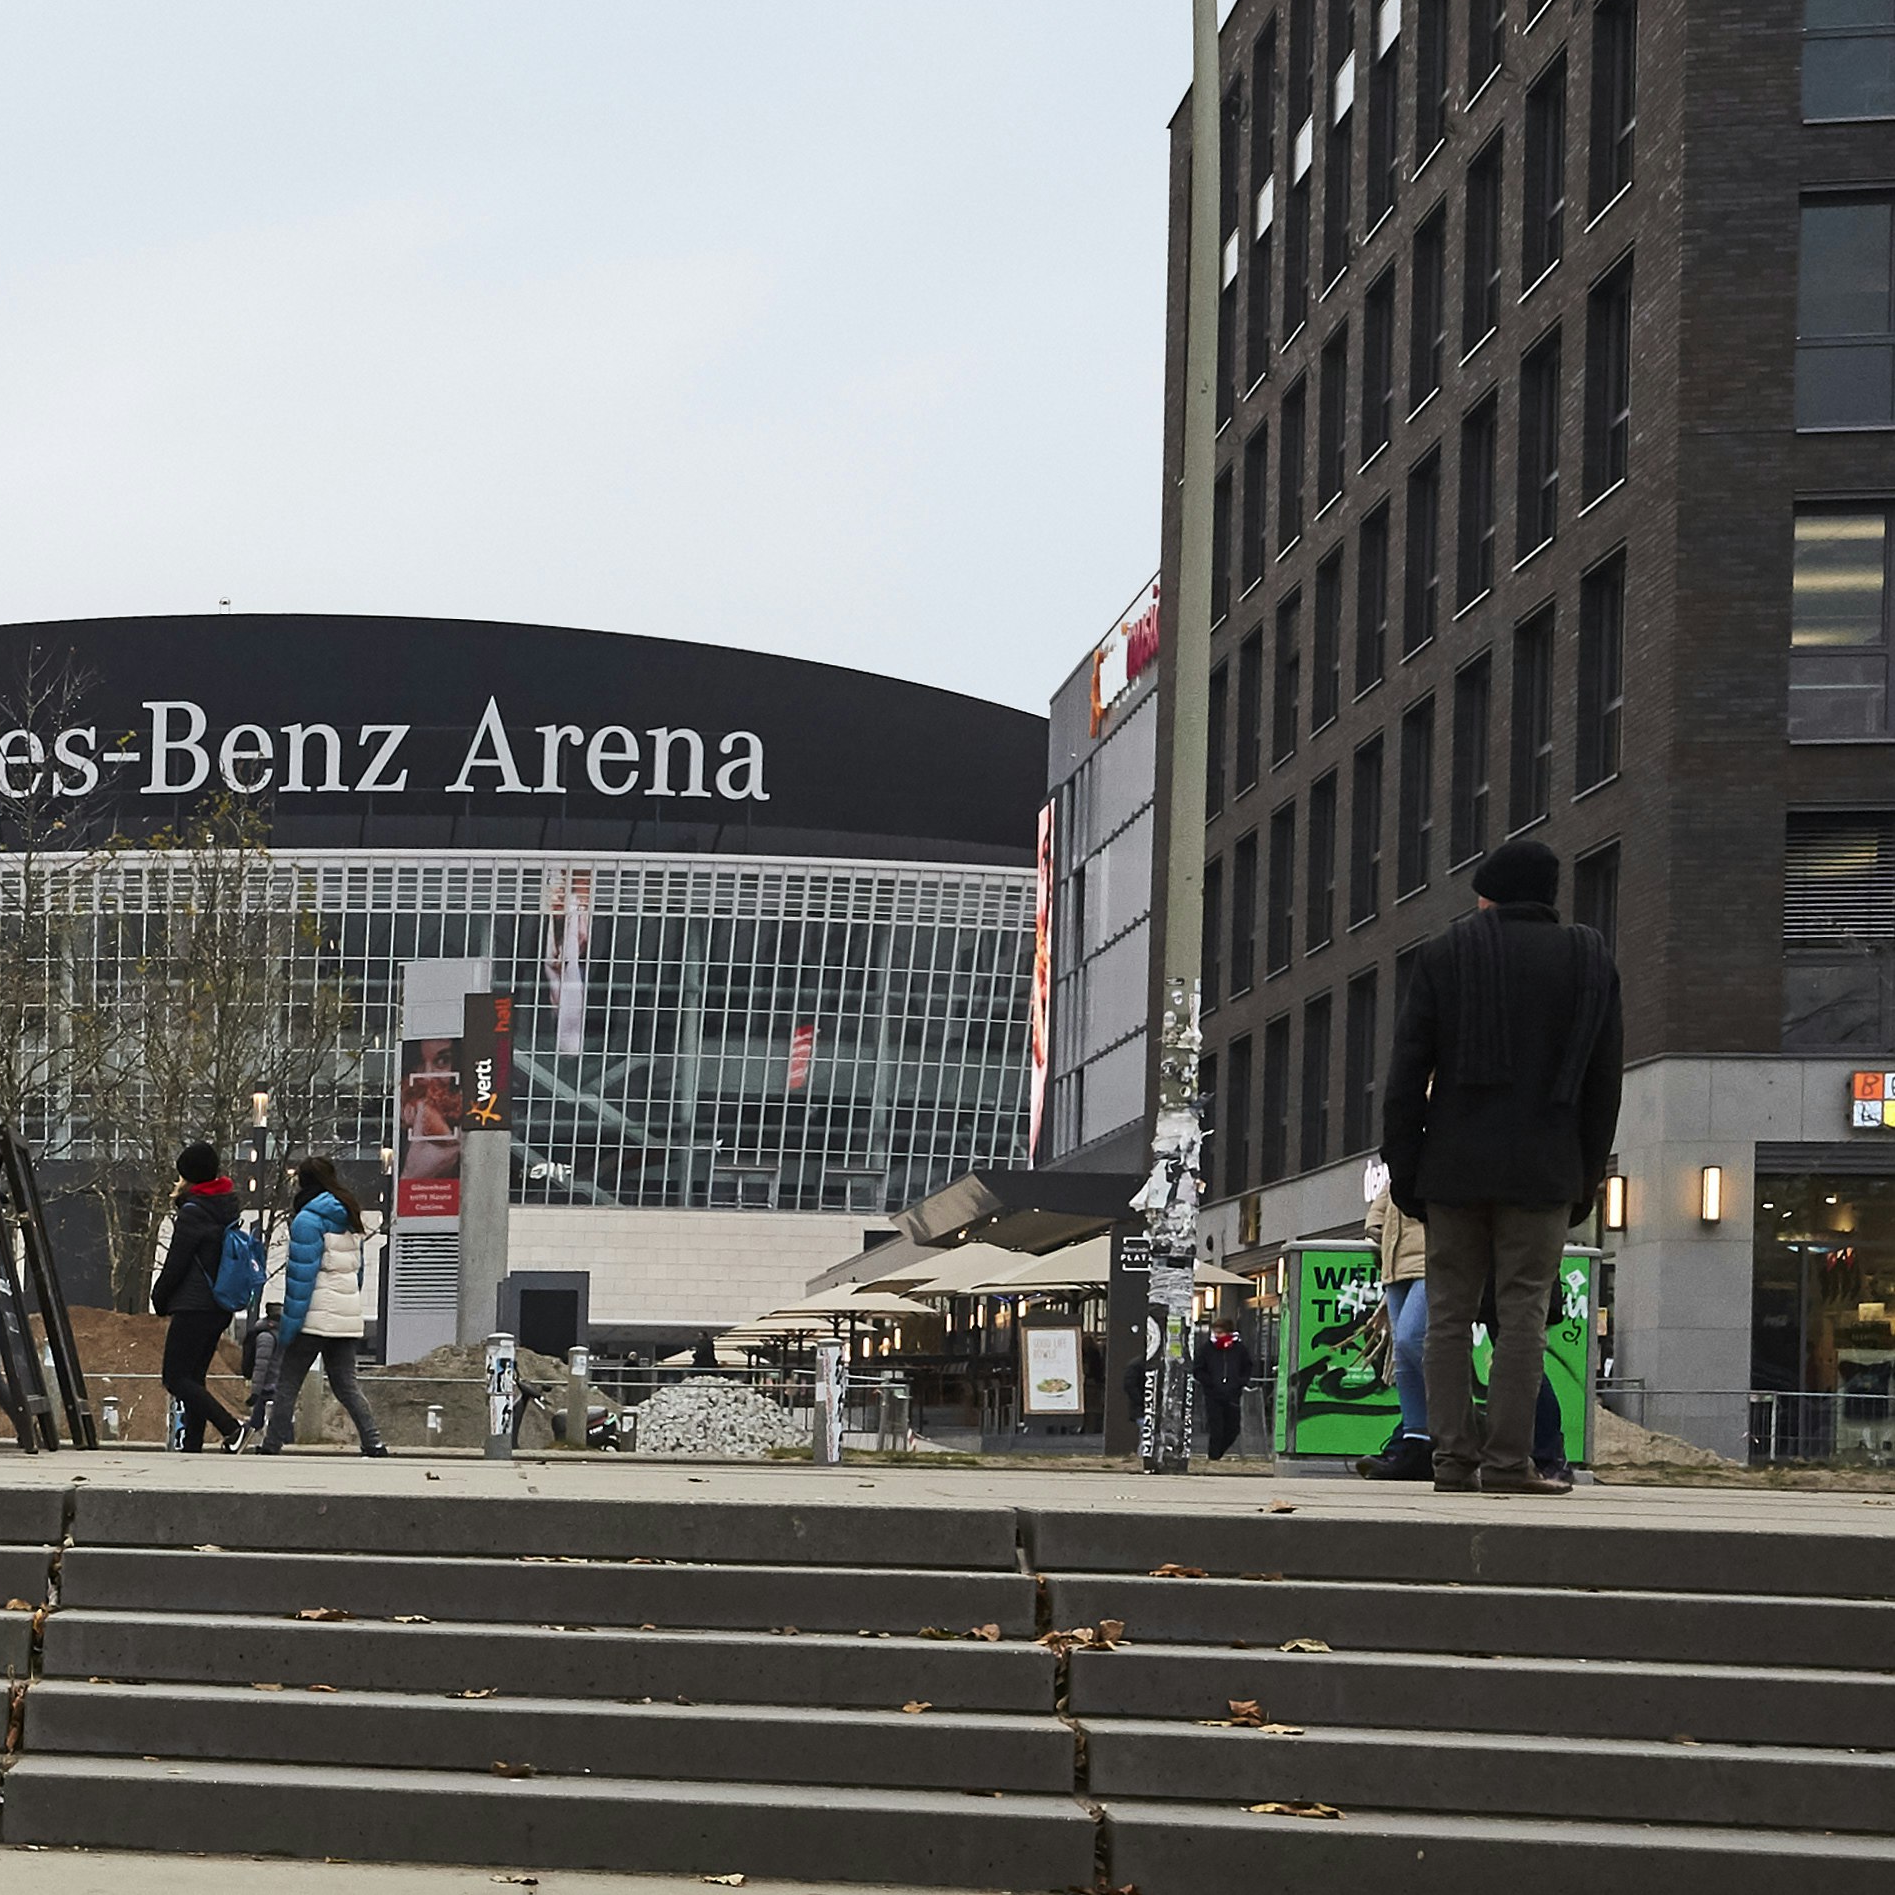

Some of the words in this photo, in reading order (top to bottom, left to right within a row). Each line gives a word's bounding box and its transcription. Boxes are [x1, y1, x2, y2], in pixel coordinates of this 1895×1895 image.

[445, 695, 770, 801] Arena
[495, 998, 512, 1033] hall
[475, 1058, 492, 1102] verti
[1142, 1370, 1157, 1458] MUSEUM
